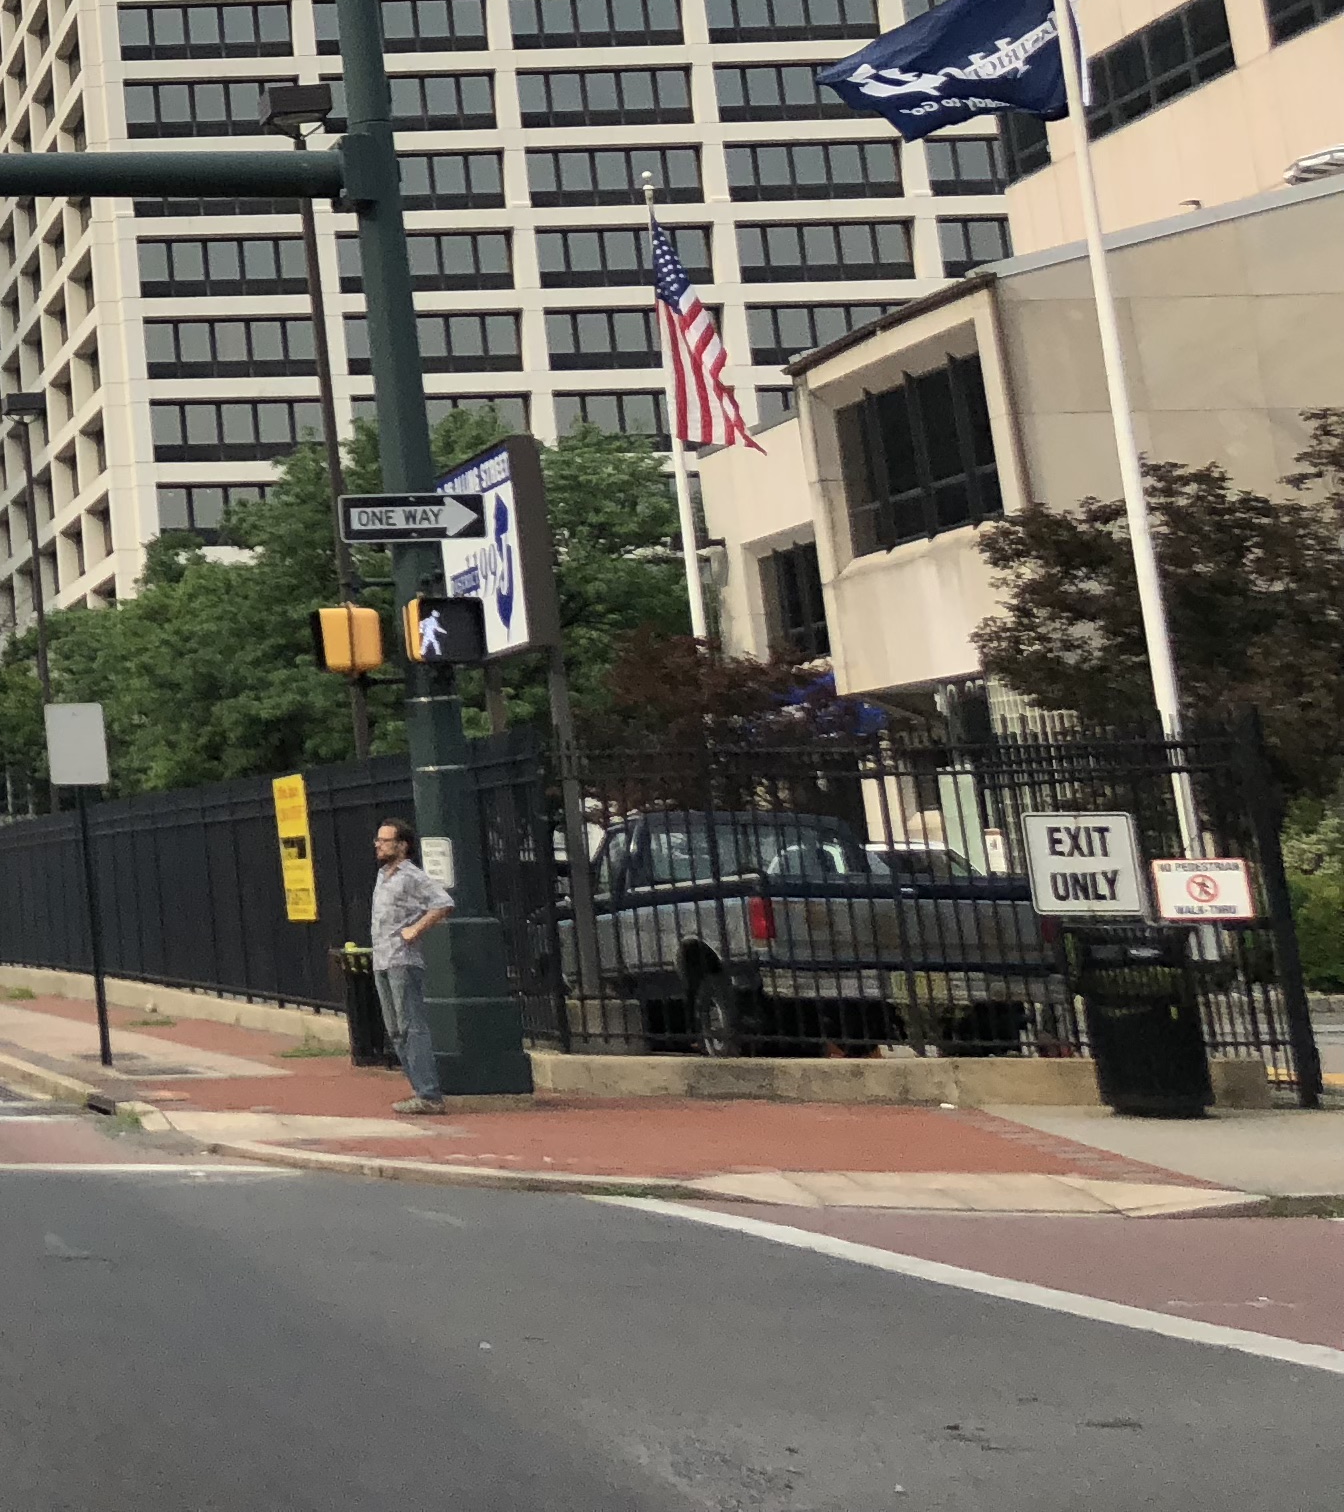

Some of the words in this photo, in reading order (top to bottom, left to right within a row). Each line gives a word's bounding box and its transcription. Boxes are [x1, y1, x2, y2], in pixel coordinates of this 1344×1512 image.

[357, 509, 397, 527] ONE
[402, 508, 443, 526] WAY
[1046, 826, 1110, 857] EXIT
[1050, 869, 1119, 901] ONLY
